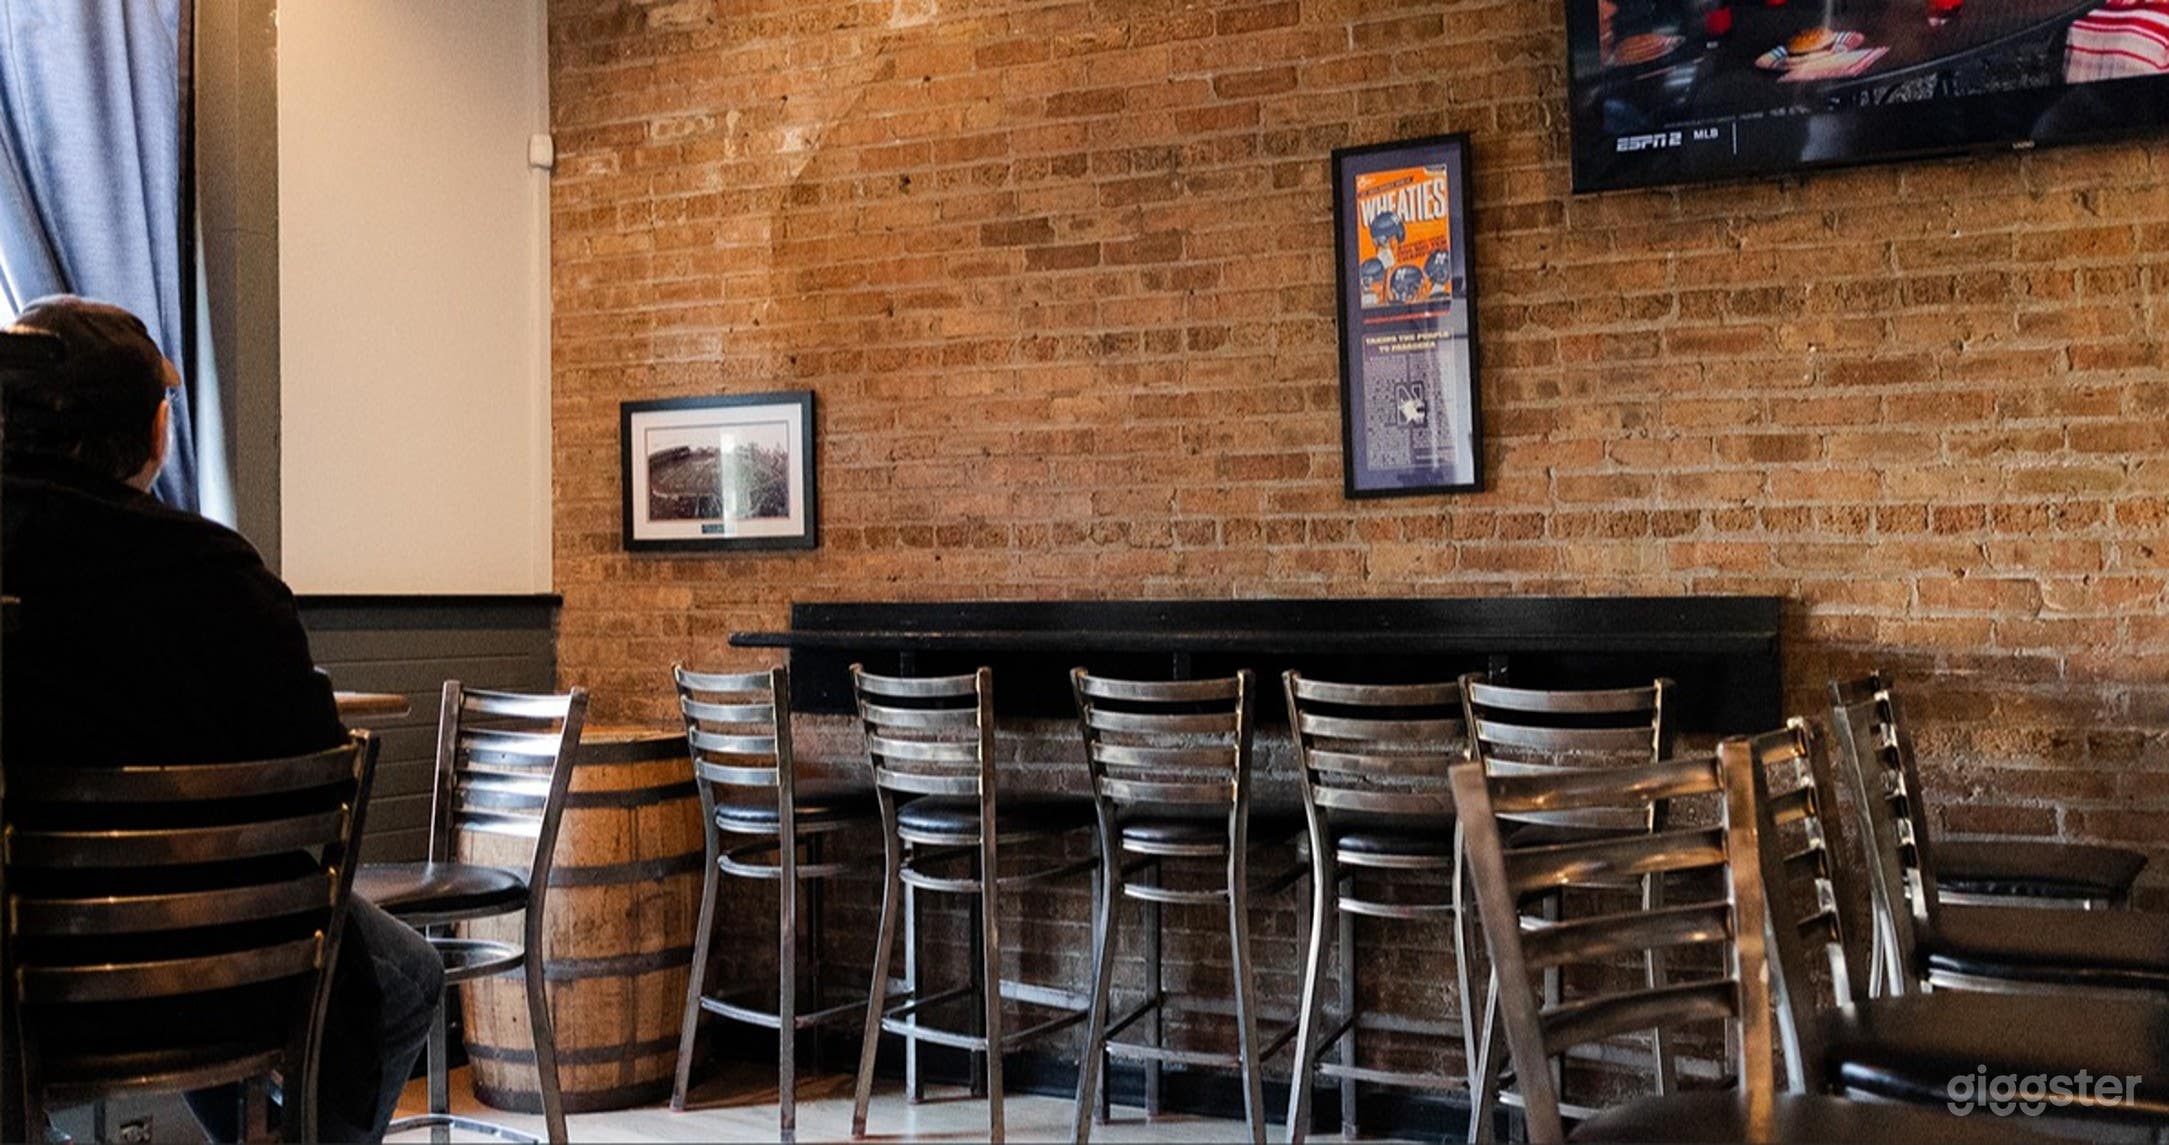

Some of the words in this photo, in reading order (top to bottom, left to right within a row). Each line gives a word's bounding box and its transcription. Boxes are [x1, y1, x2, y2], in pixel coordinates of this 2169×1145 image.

[1693, 127, 1719, 140] MLB
[1360, 177, 1447, 227] WHEATIES
[1398, 333, 1416, 343] THE
